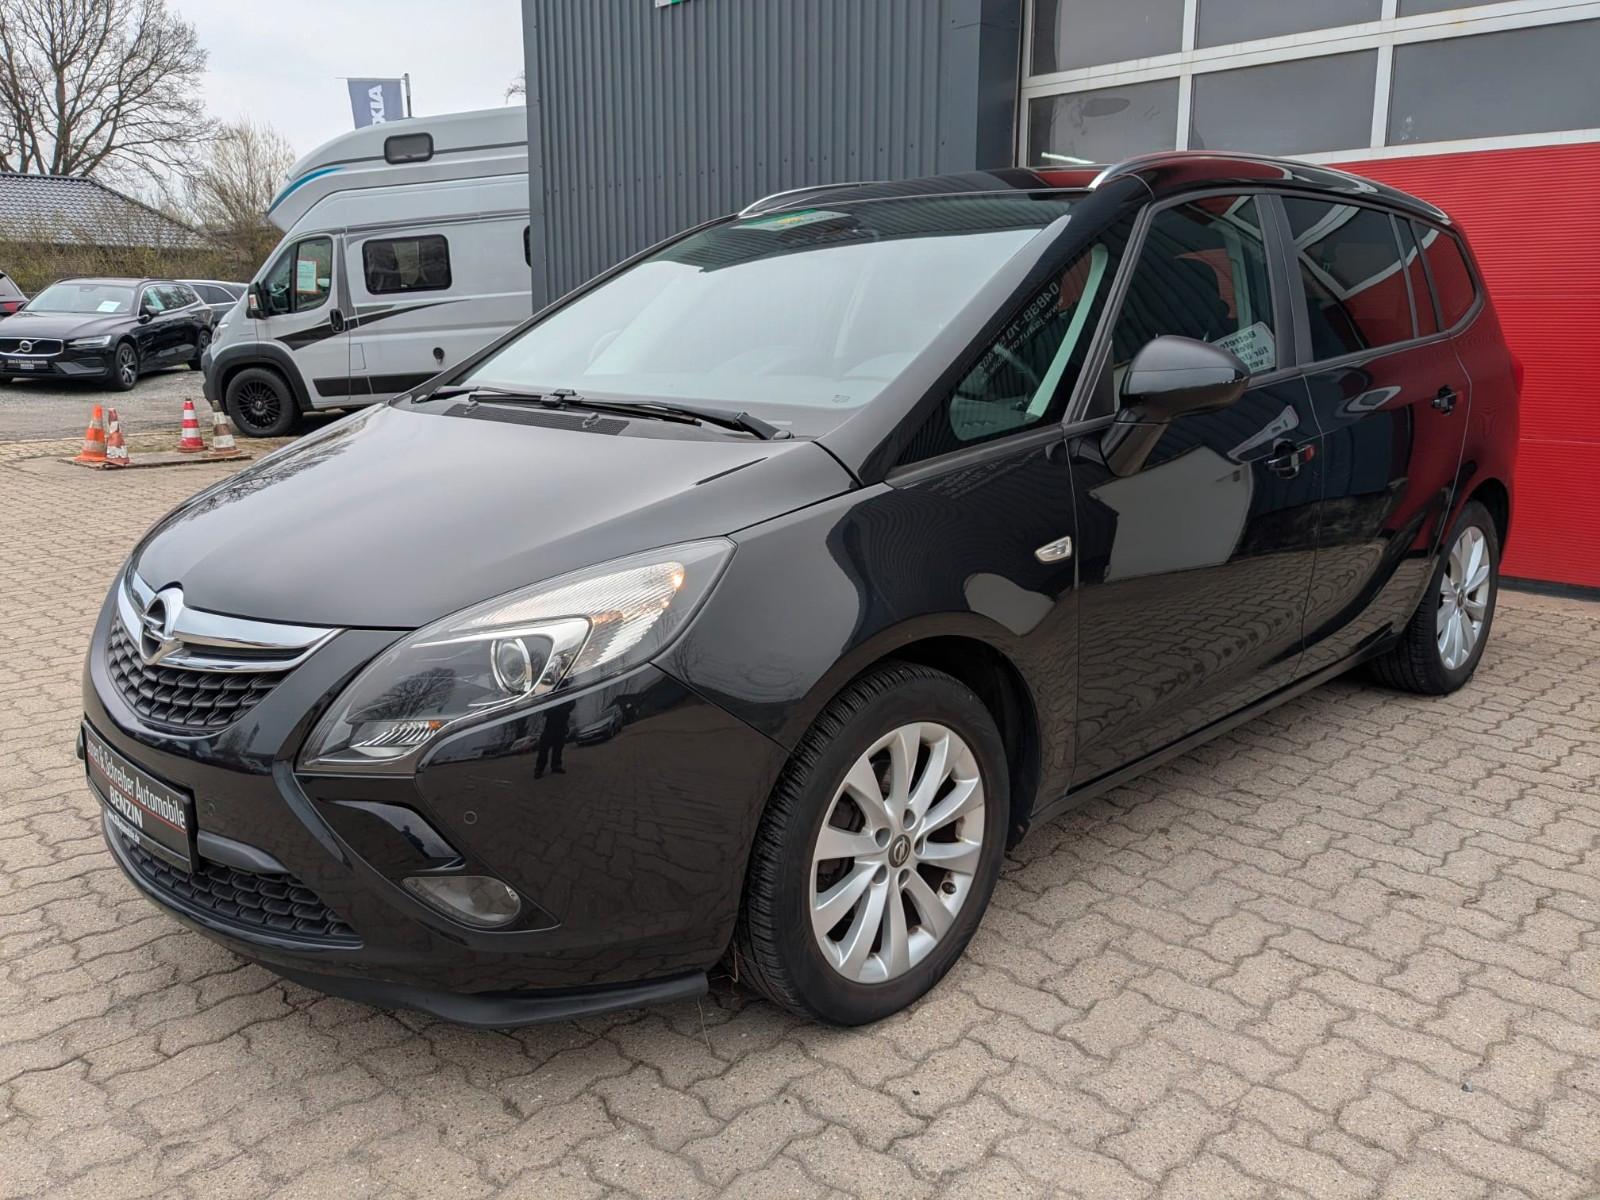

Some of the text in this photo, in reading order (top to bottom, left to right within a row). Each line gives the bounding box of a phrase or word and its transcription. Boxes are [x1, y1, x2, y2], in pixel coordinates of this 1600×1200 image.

[104, 752, 135, 799] Schreiber
[136, 776, 186, 829] Automobile
[109, 786, 143, 829] BENZIN
